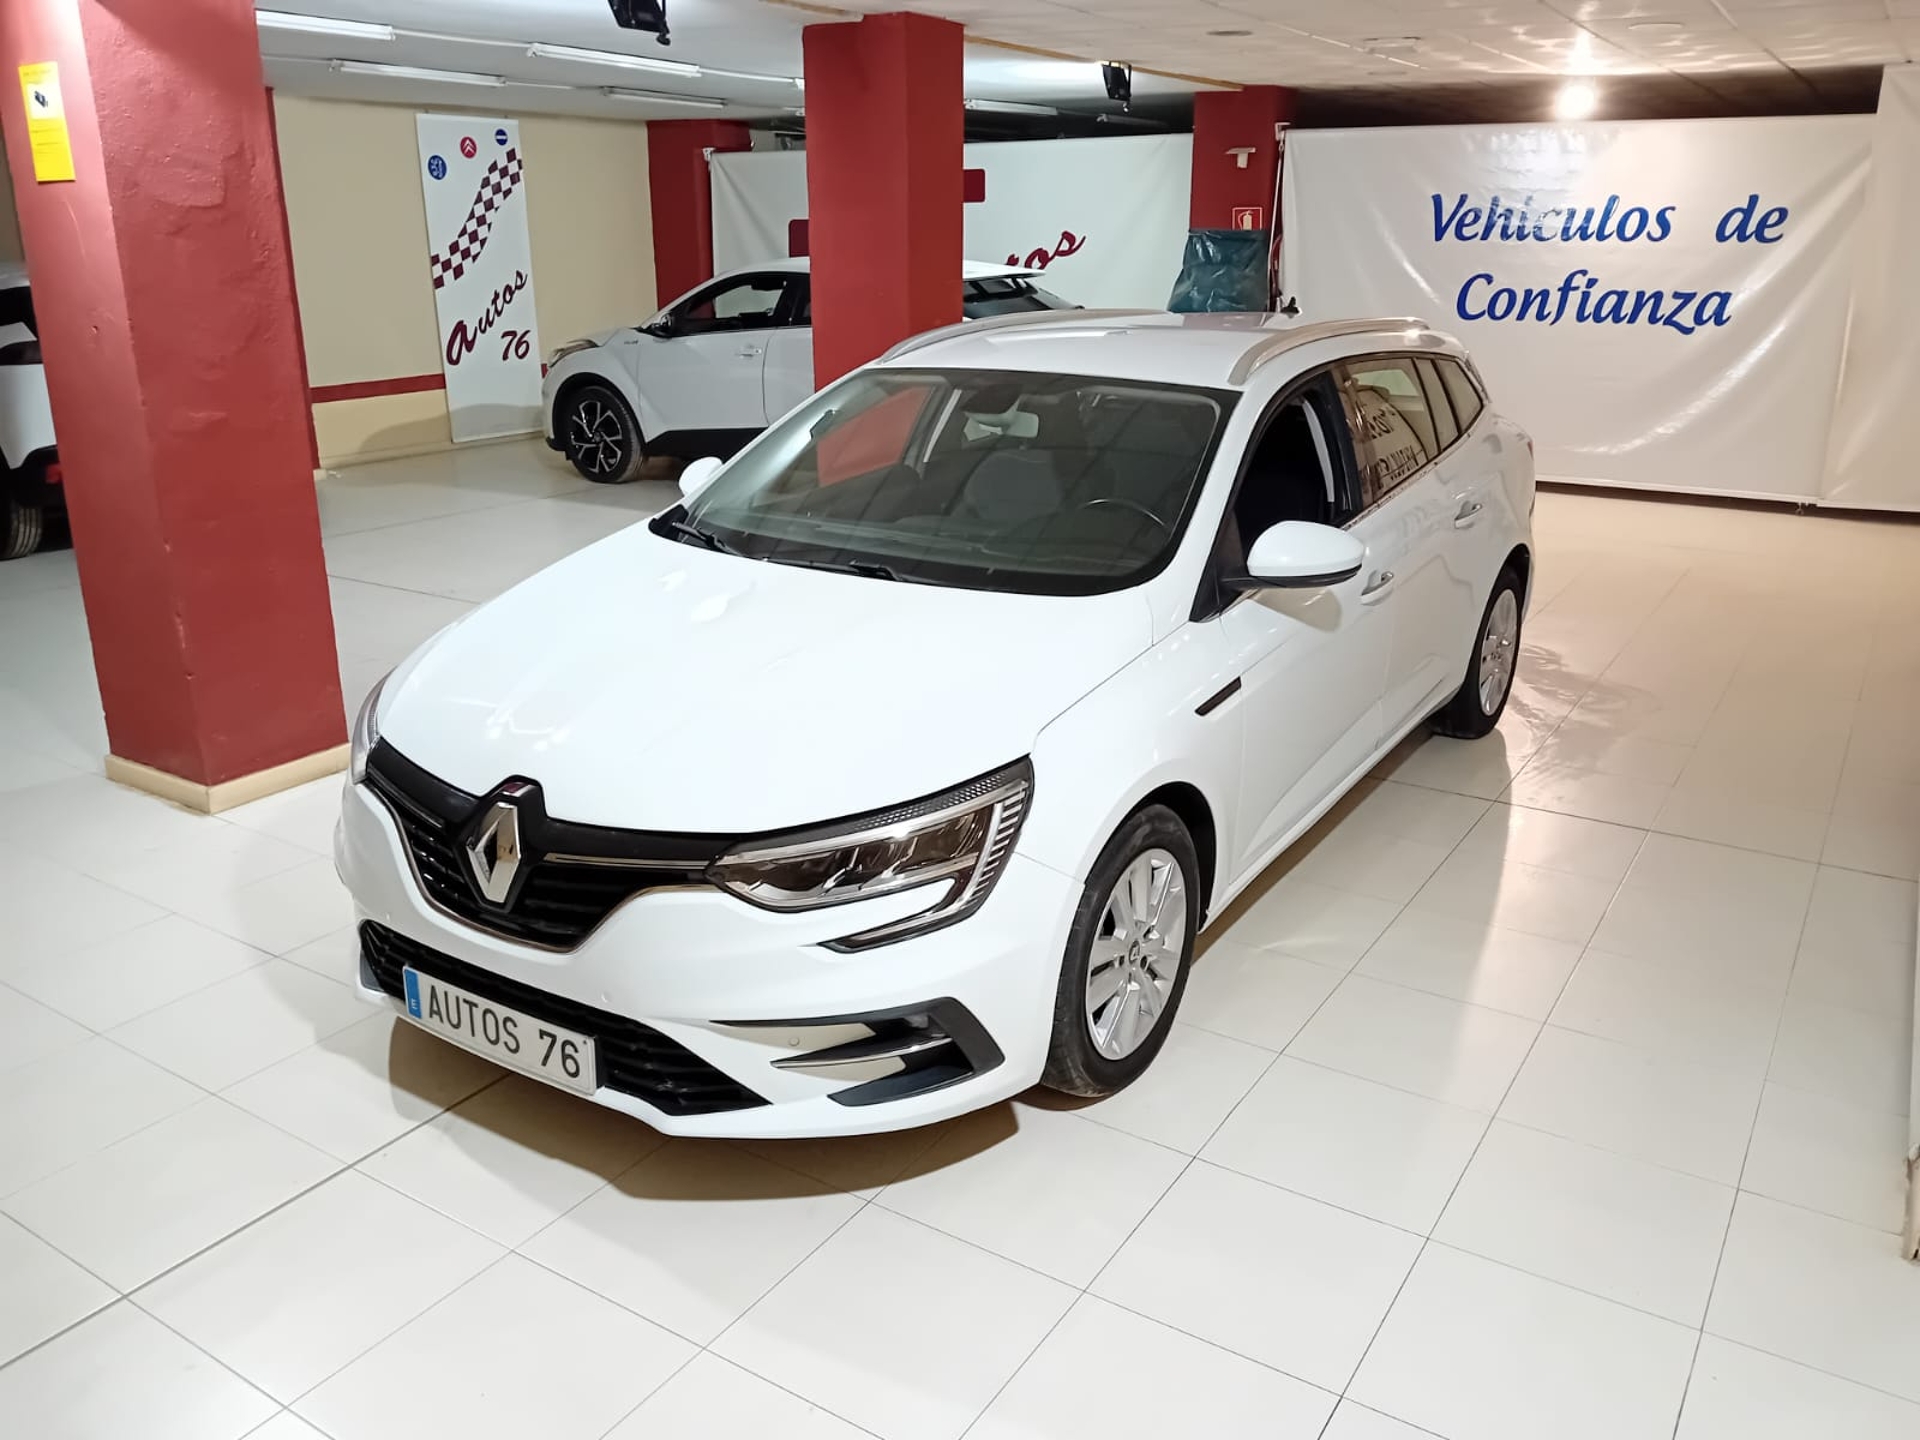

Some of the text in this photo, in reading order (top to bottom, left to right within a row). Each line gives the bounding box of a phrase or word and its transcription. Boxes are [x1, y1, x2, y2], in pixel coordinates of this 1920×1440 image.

[1715, 194, 1789, 243] de
[446, 270, 528, 366] Autos
[1456, 269, 1733, 335] Confianza
[501, 330, 531, 361] 76
[429, 985, 580, 1078] AUTOS 76
